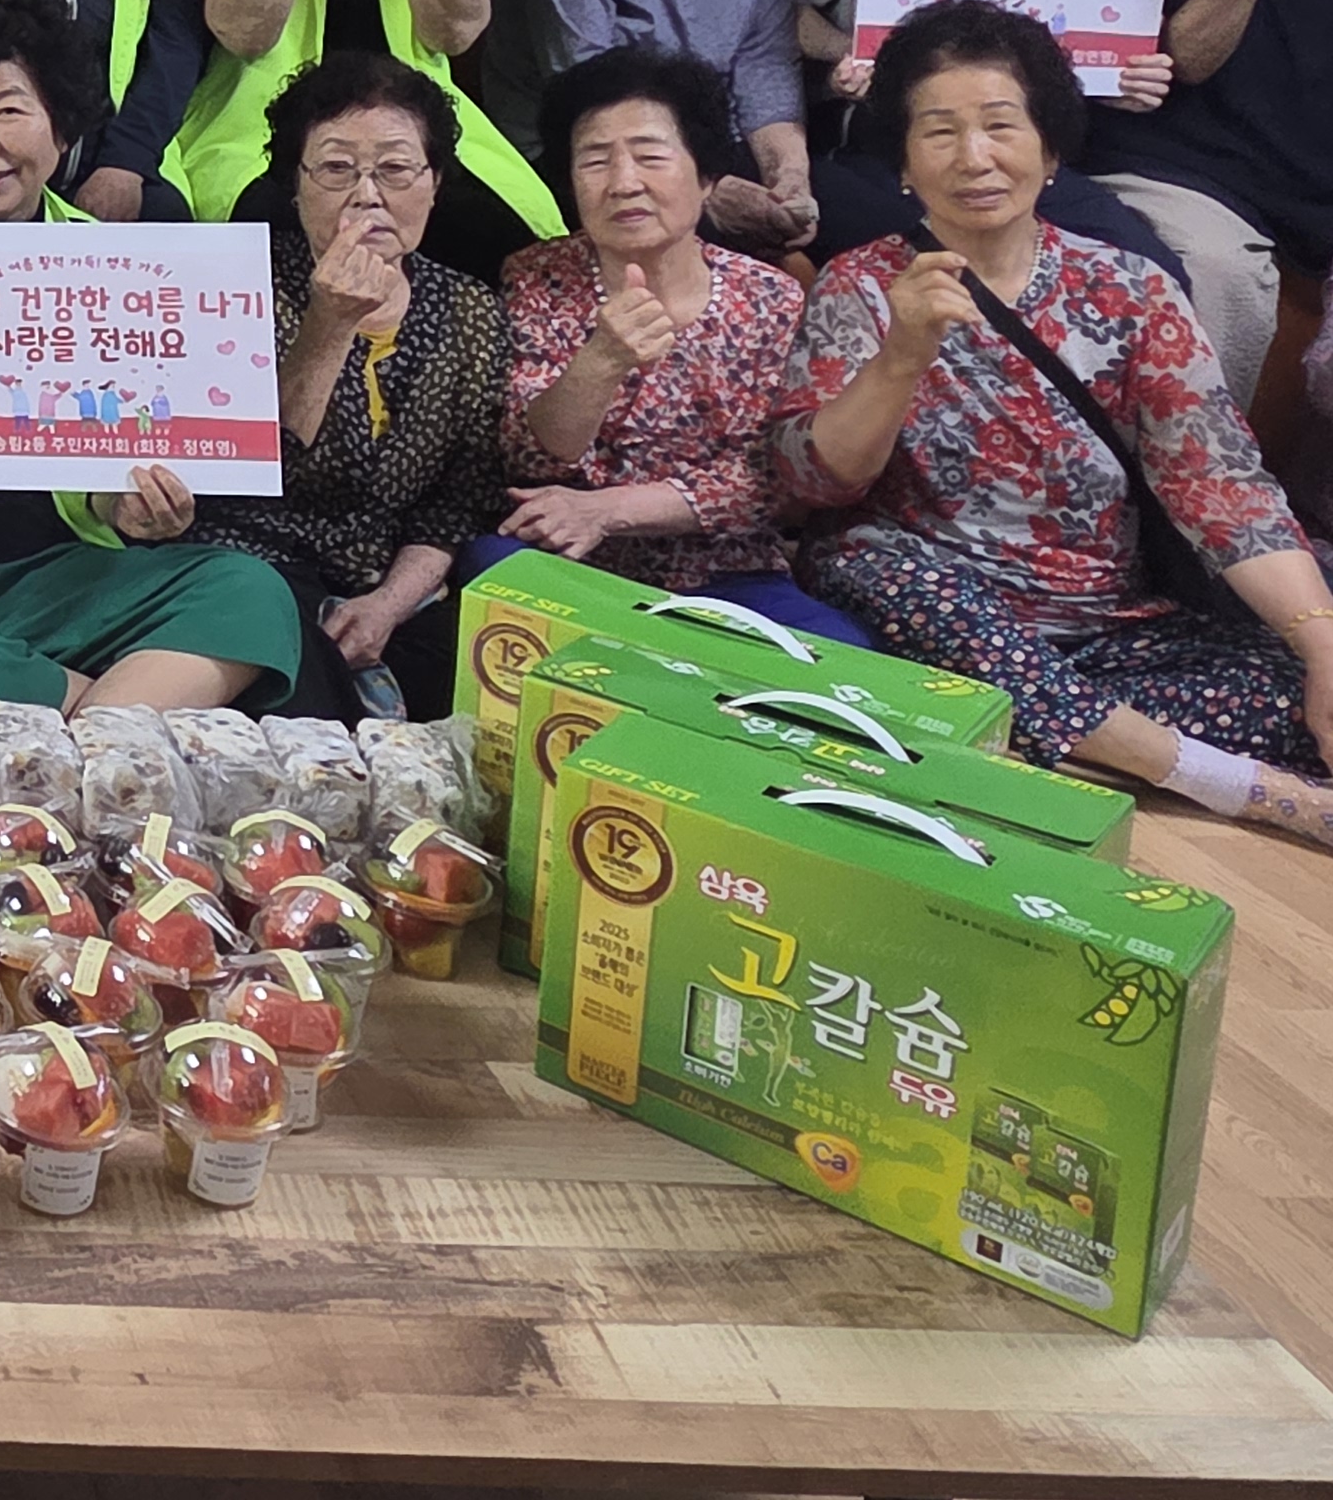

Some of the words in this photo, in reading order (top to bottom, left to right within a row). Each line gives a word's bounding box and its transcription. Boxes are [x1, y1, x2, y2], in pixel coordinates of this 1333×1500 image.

[11, 285, 111, 323] 건강한
[123, 286, 186, 324] 여름
[199, 290, 264, 319] 나기
[90, 327, 188, 362] 전해요
[51, 437, 130, 454] 주민자치회
[133, 438, 170, 456] (회장
[480, 581, 534, 603] GIFT
[533, 598, 580, 617] SET
[578, 758, 646, 788] GIFT
[644, 779, 701, 804] SET
[699, 864, 769, 914] 삼육
[599, 919, 631, 941] 2025
[708, 912, 970, 1081] 고칼슘
[890, 1069, 957, 1118] 두유
[812, 1142, 849, 1172] Ca
